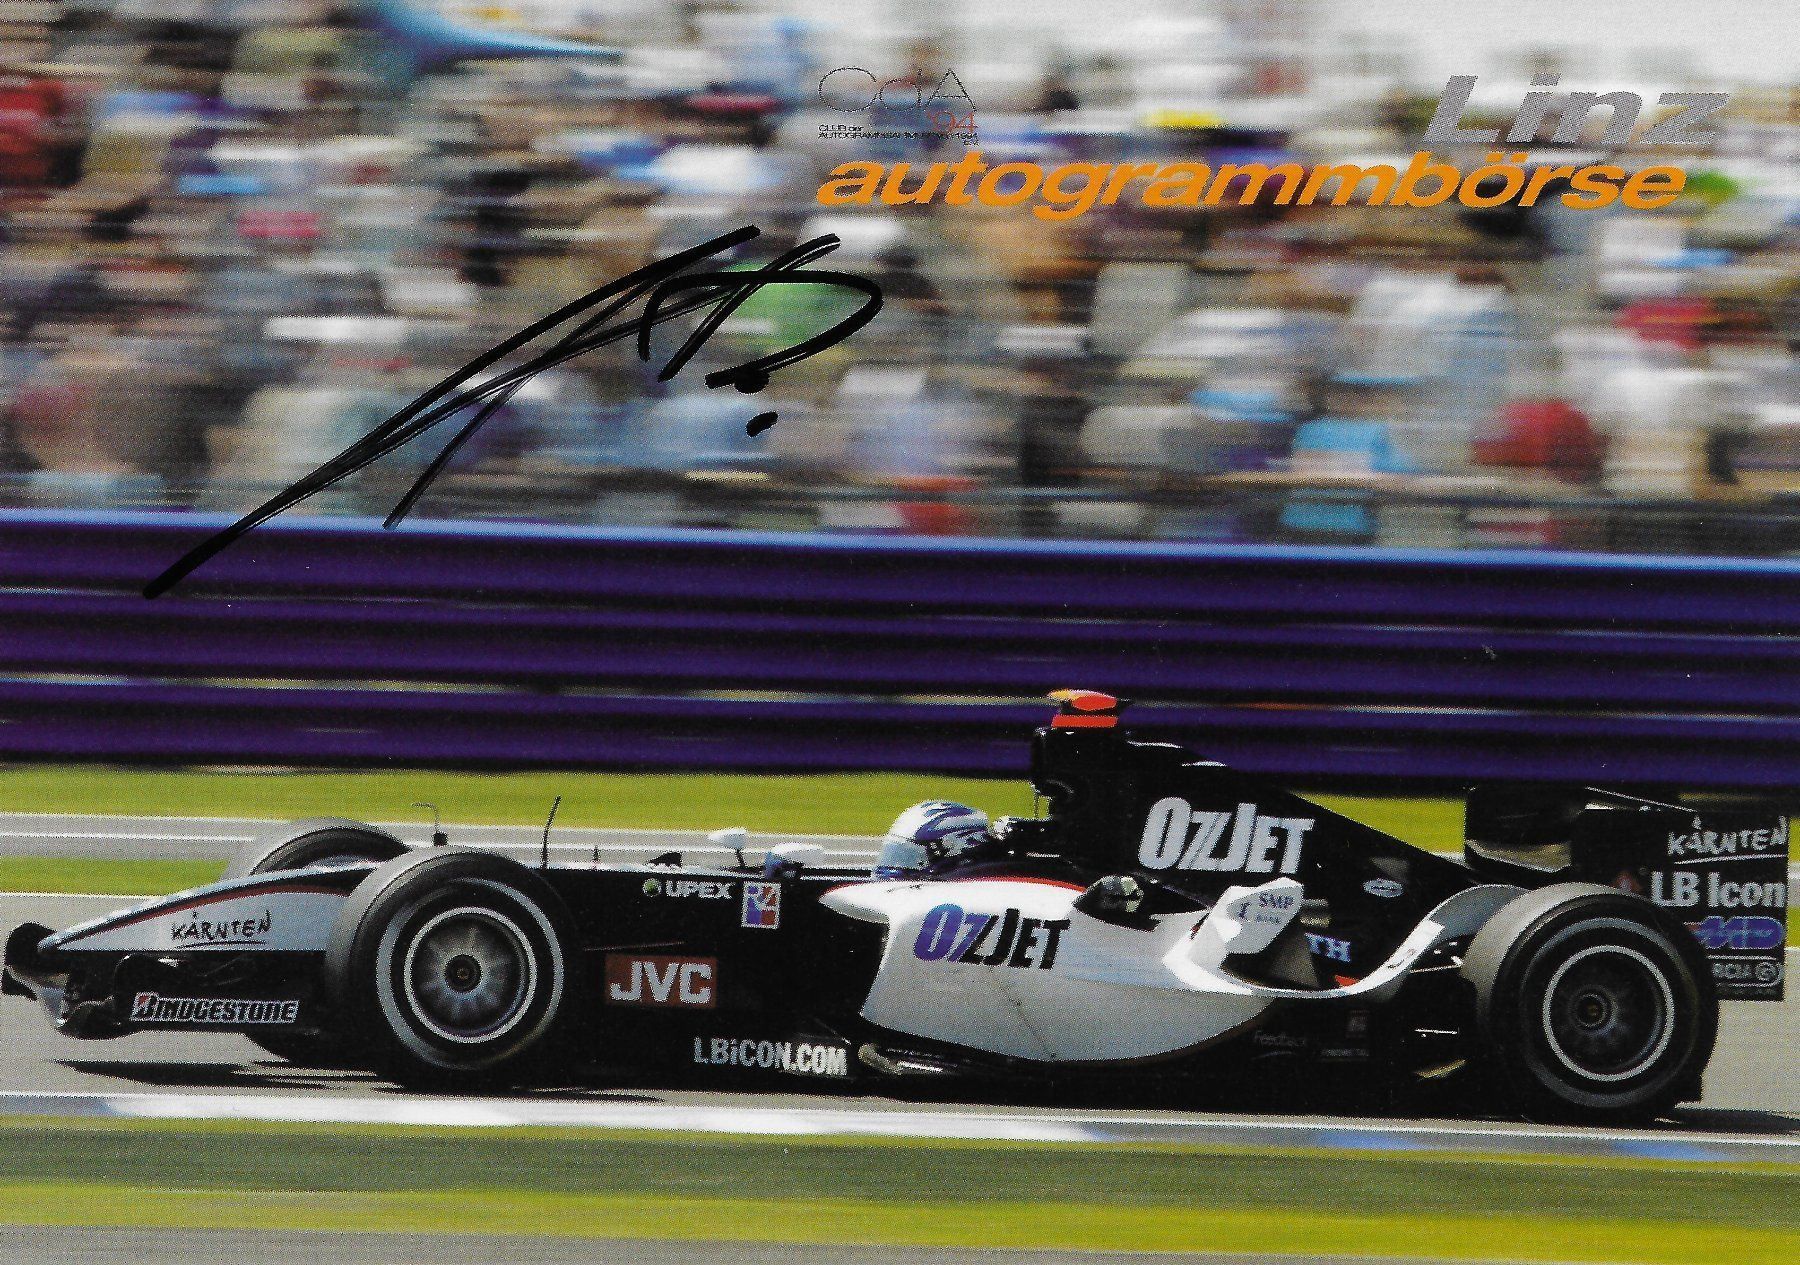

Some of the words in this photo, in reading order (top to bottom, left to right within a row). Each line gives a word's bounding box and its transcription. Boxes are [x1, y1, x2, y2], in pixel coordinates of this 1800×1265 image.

[665, 880, 733, 900] UPEX
[1259, 892, 1294, 909] SMP
[1650, 870, 1700, 908] LB
[610, 960, 713, 1004] JVC
[129, 991, 300, 1024] BRIDGESTONE
